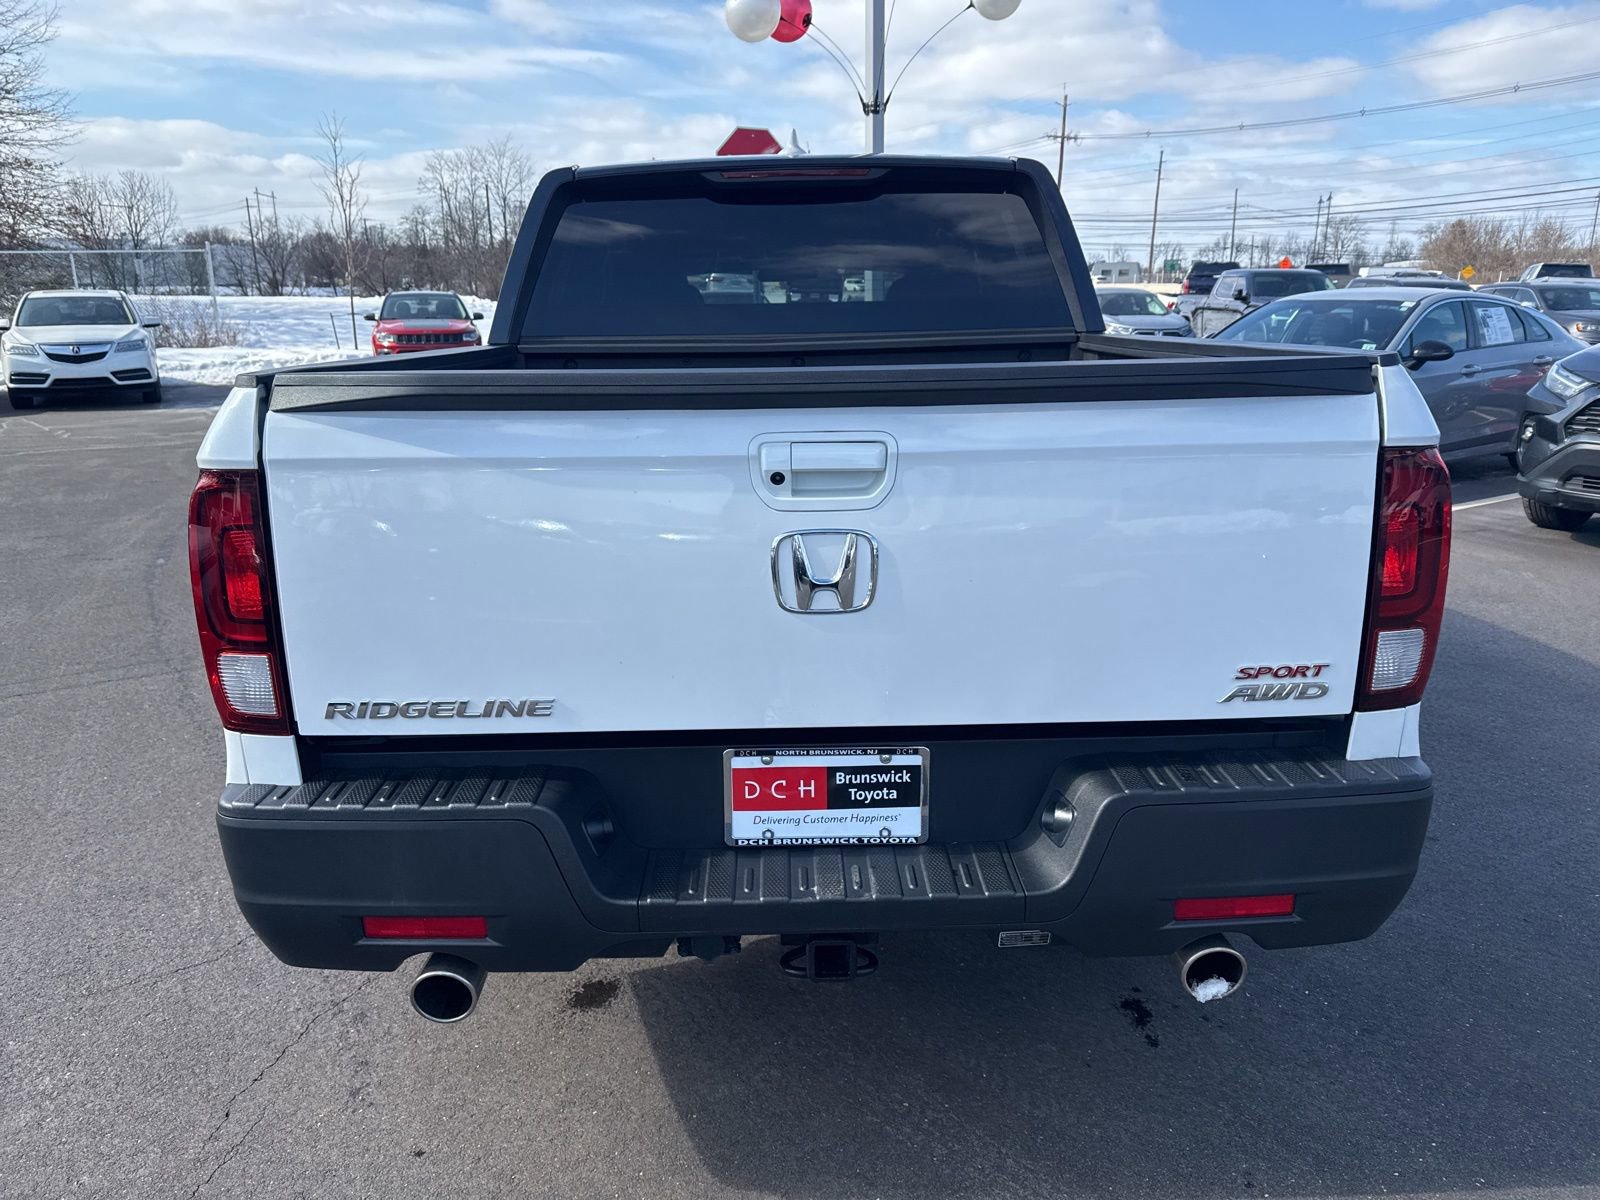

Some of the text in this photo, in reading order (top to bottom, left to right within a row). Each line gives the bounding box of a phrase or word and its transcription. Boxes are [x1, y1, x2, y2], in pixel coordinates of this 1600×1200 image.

[1234, 664, 1330, 680] SPORT
[1216, 682, 1329, 703] AWD
[324, 698, 556, 720] RIDGELINE
[836, 770, 911, 784] Brunswick
[849, 788, 897, 803] Toyota
[753, 815, 801, 826] Delivering
[803, 814, 848, 824] Customer
